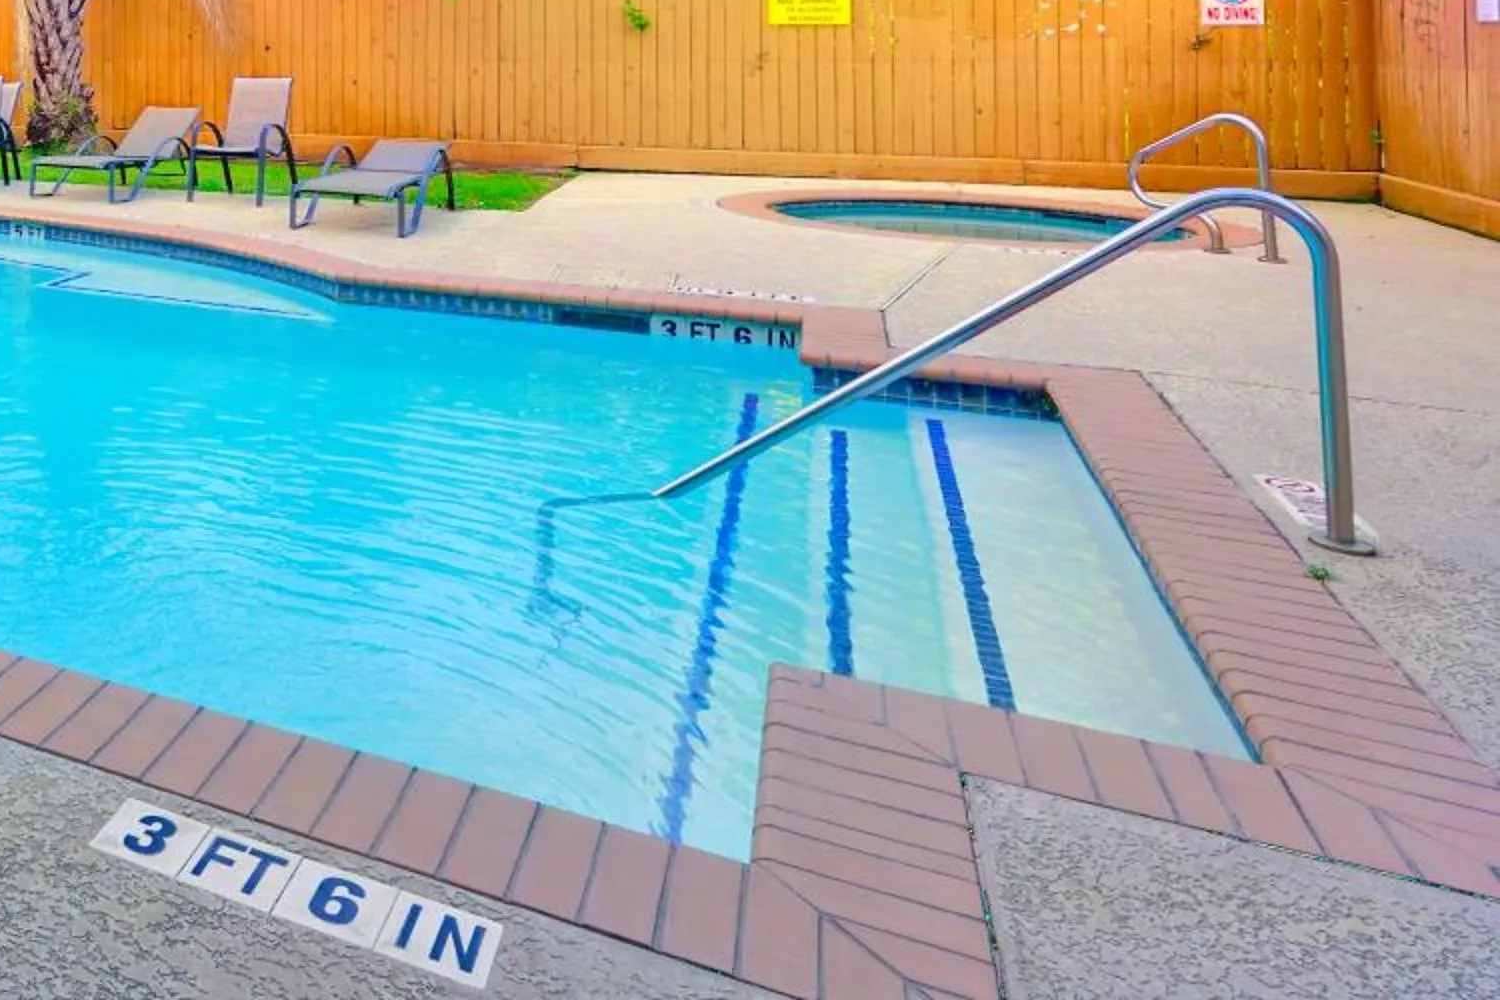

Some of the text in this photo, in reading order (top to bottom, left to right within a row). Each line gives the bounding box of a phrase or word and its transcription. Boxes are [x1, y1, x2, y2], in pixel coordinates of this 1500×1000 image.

[1207, 7, 1258, 21] NO DIVING
[661, 319, 796, 349] 3 FT 6 IN
[122, 815, 487, 974] 3 FT 6 IN
